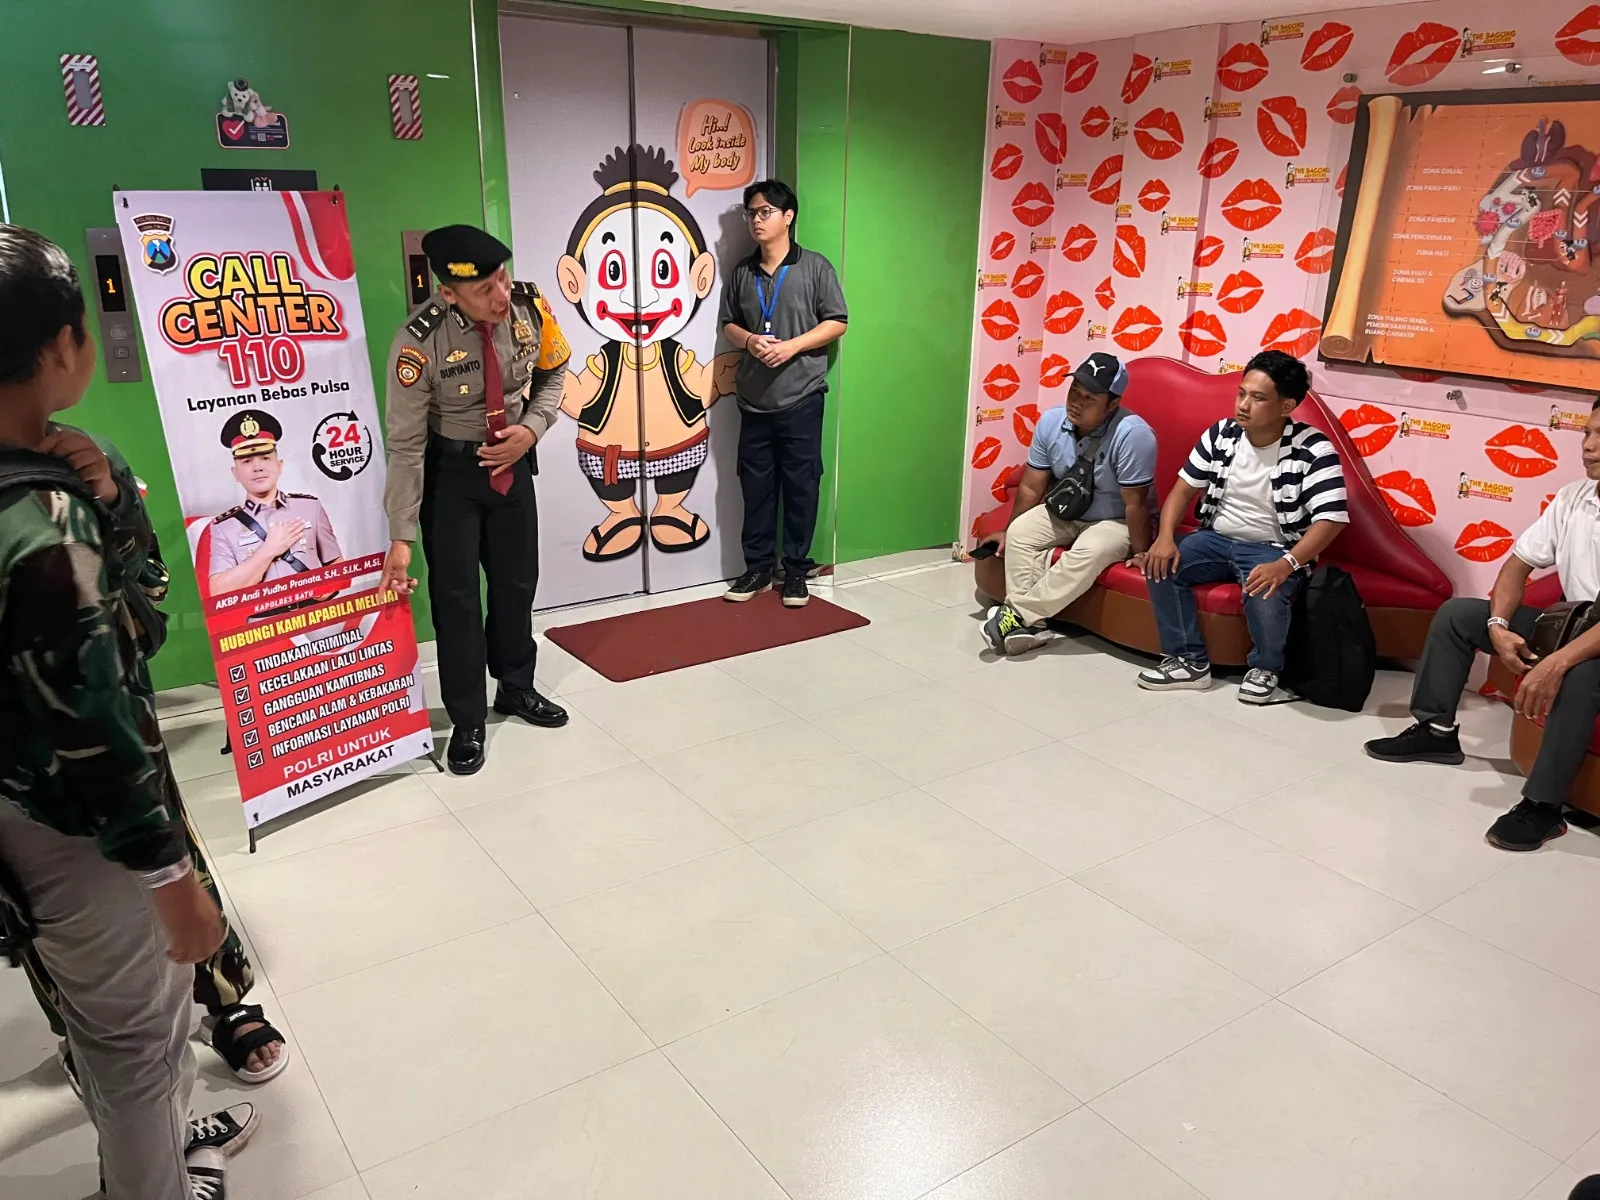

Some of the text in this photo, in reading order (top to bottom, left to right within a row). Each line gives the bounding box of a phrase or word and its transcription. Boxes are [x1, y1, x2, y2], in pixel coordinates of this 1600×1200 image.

[1486, 30, 1516, 39] BAGONG
[688, 132, 746, 154] Look inside
[690, 152, 740, 174] My body
[106, 278, 116, 294] 1
[188, 255, 304, 300] CALL
[416, 274, 424, 288] 1
[163, 294, 341, 345] CENTER
[1366, 322, 1407, 330] PEMERIKSAAN
[219, 336, 301, 385] 110
[187, 380, 350, 412] Layanan Bebas Pulsa
[1422, 420, 1450, 430] BAGONG
[1560, 412, 1572, 420] THE
[1574, 414, 1588, 422] BAG
[326, 424, 361, 448] 24
[329, 446, 362, 460] HOUR
[330, 455, 365, 467] SERVICE
[1469, 480, 1514, 492] THE BAGONG
[216, 596, 239, 610] AKBP
[241, 589, 260, 602] Andi
[262, 584, 288, 597] Yudha
[254, 590, 314, 612] KAPOLRES BATU
[220, 626, 275, 652] HUBUNGI
[276, 614, 306, 635] KAMI
[308, 600, 354, 626] APABILA
[254, 628, 364, 673] TINDAKAN KRIMINAL
[259, 640, 394, 694] KECELAKAAN LALU LINTAS
[264, 664, 385, 716] GANGGUAN KAMTIBNAS
[268, 674, 414, 738] BENCANA ALAM & KEBAKARAN
[272, 695, 410, 758] INFORMASI LAYANAN POLRI
[283, 726, 392, 778] POLRI UNTUK
[286, 745, 396, 798] MASYARAKAT
